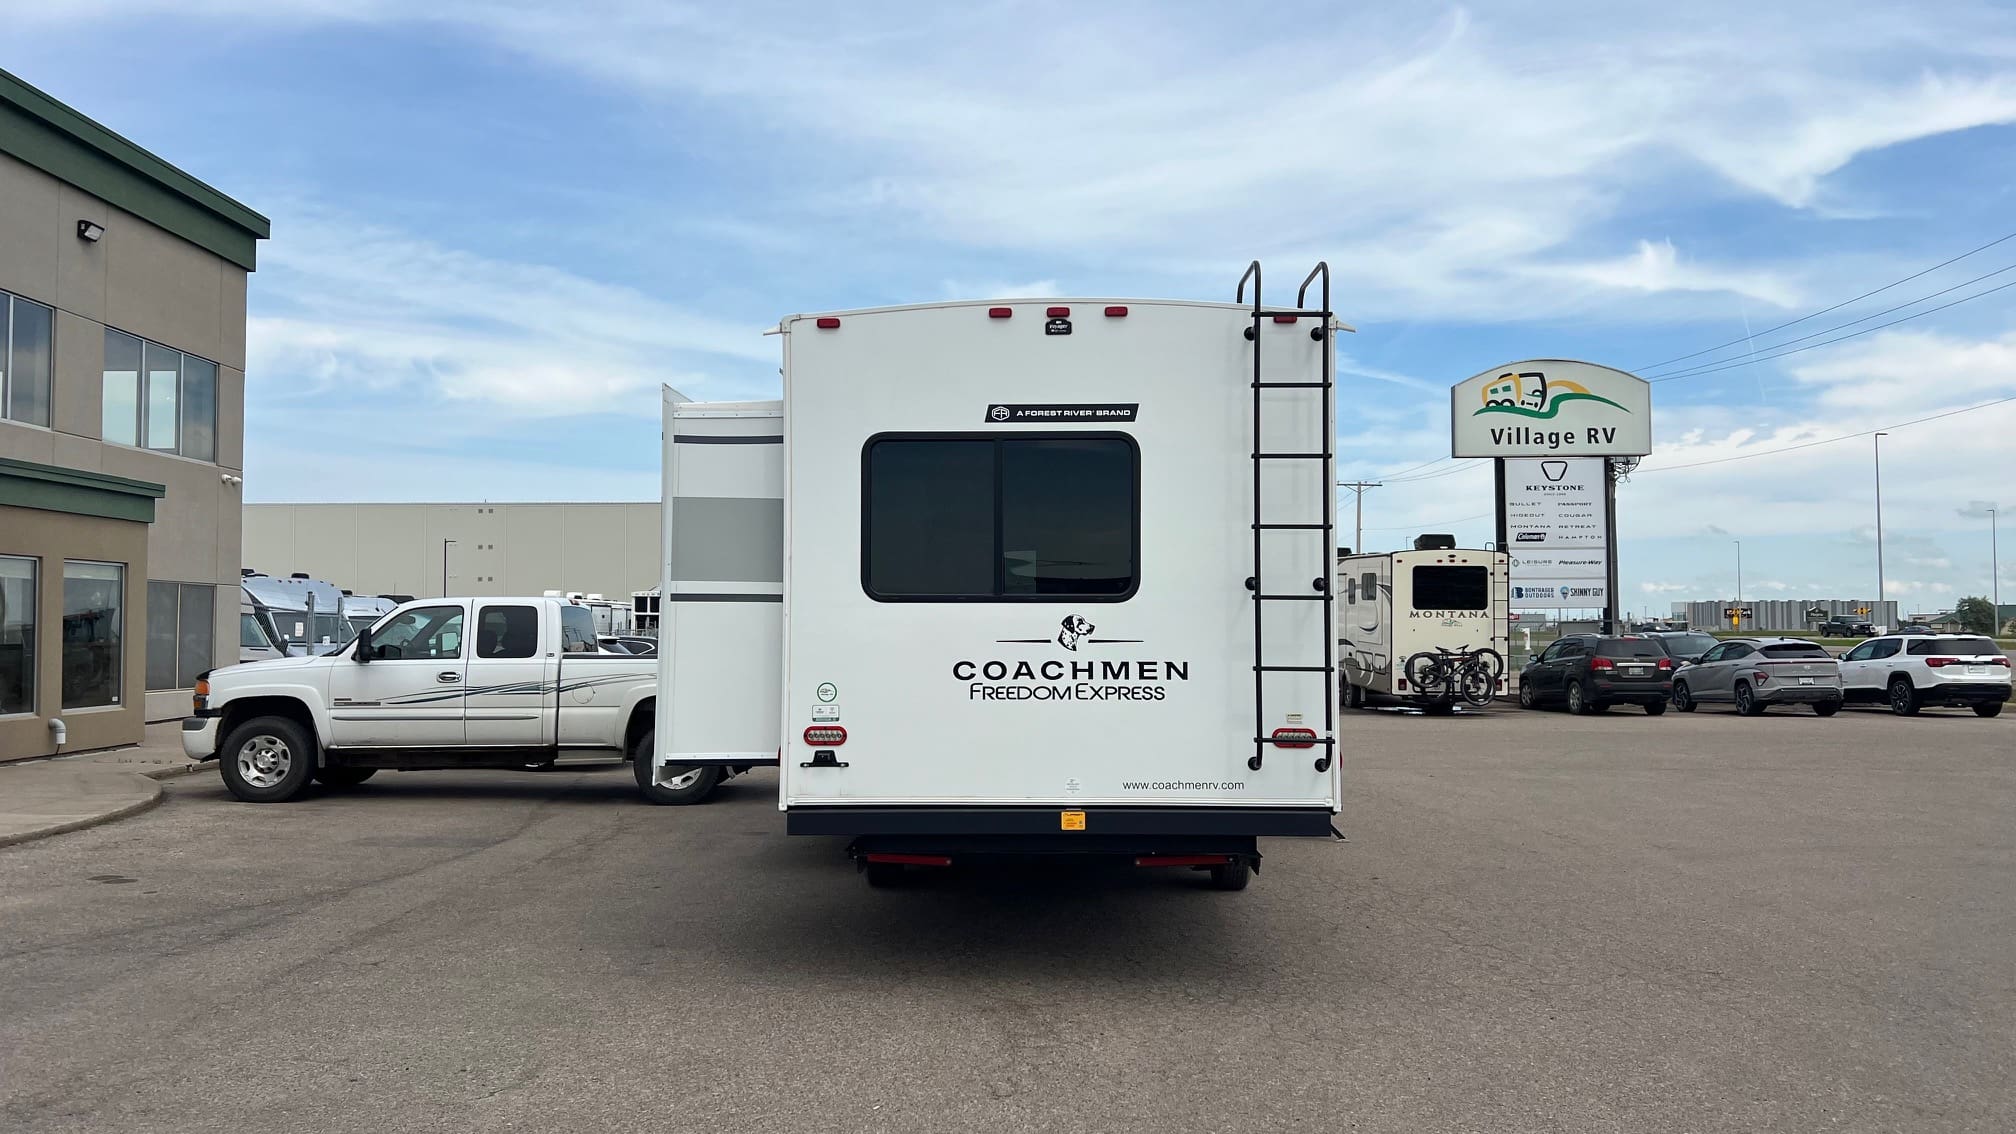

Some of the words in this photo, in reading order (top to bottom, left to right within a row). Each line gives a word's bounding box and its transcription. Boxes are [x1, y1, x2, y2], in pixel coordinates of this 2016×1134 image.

[1490, 427, 1576, 449] Village
[1587, 427, 1617, 444] RV
[1570, 587, 1591, 597] SKINNY
[1592, 587, 1604, 597] GUY
[1409, 610, 1490, 619] MONTANA
[951, 660, 1190, 681] COACHMEN
[1122, 780, 1245, 790] www.coachmenrv.com
